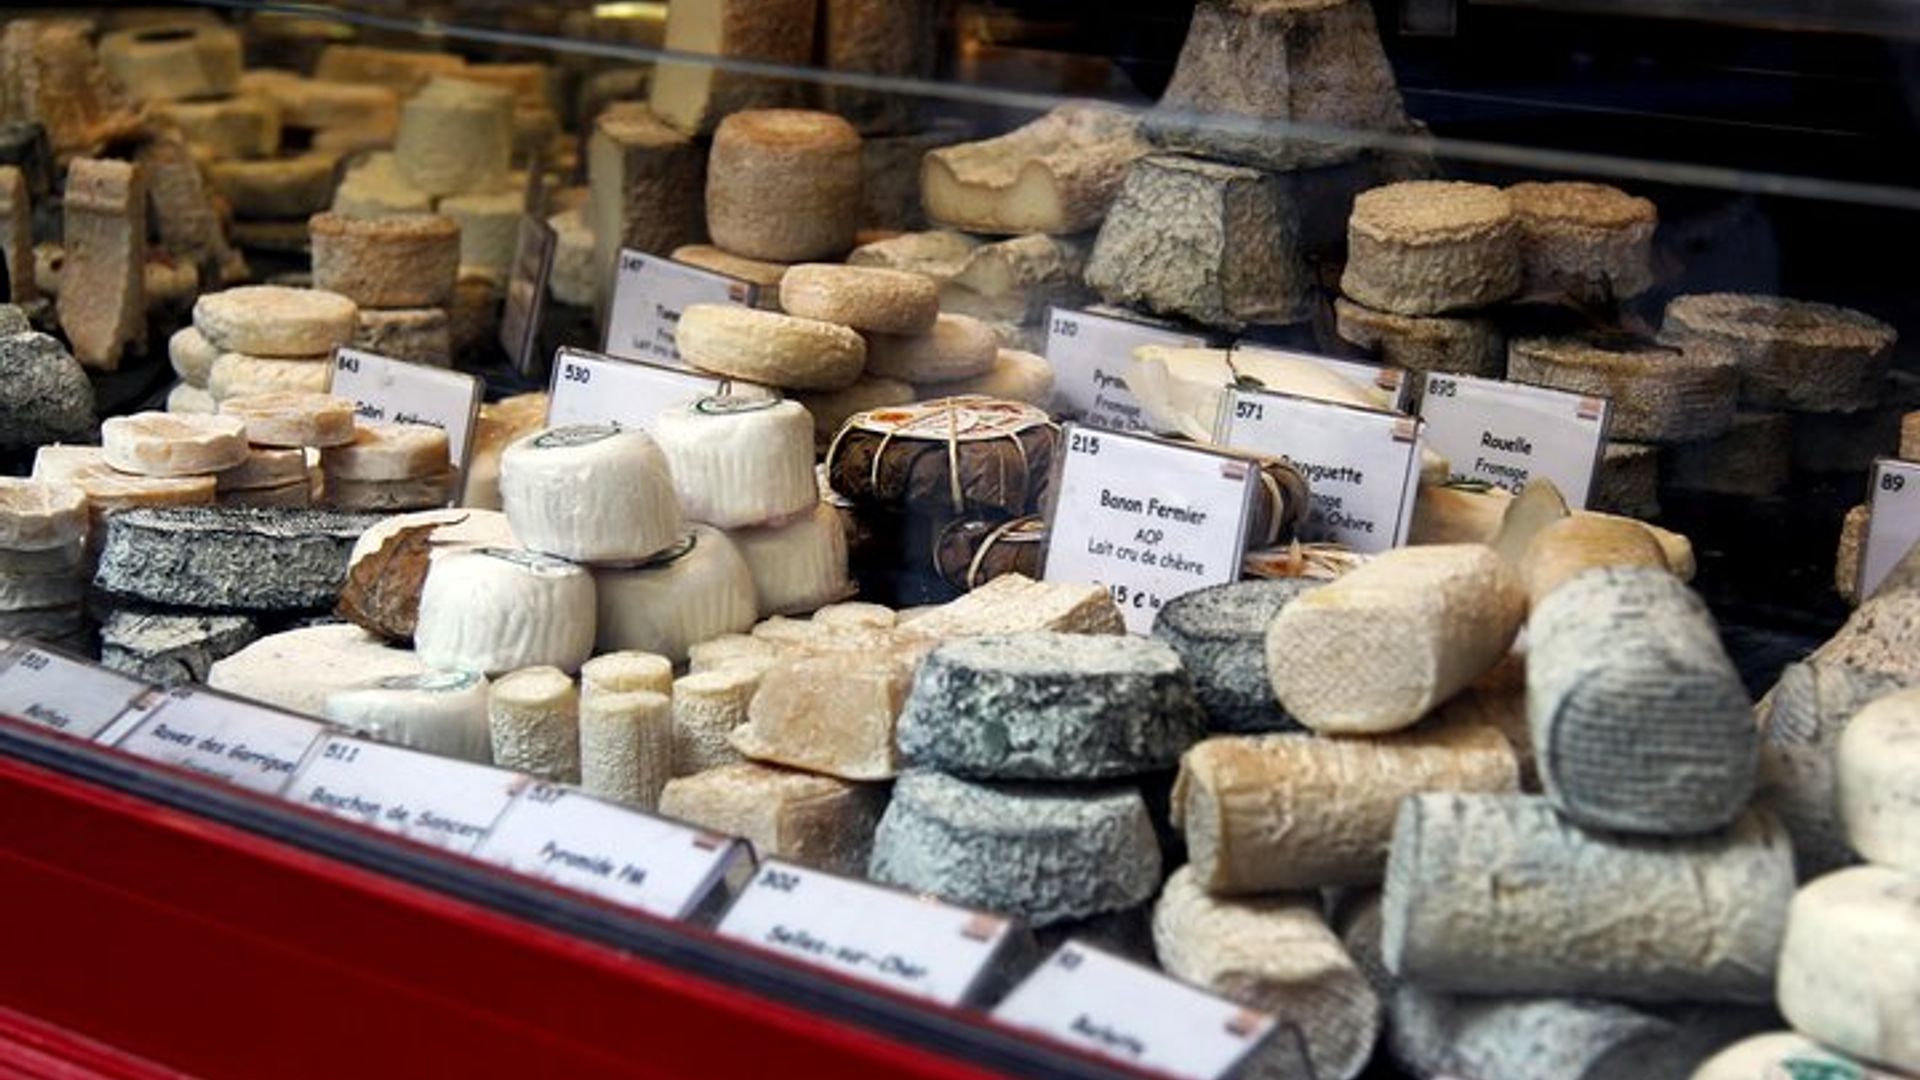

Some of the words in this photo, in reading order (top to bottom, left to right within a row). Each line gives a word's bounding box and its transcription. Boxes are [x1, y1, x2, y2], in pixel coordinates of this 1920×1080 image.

[1053, 319, 1079, 337] 120
[565, 363, 591, 384] 530
[1236, 401, 1264, 421] 571
[1071, 433, 1100, 455] 215
[1480, 430, 1533, 456] Rouelle
[1474, 457, 1529, 483] Fromage
[1881, 472, 1905, 493] 89
[1100, 488, 1142, 514] Banon
[1146, 497, 1207, 526] Fermier
[1133, 528, 1164, 546] AOP
[1087, 536, 1114, 557] Lait
[1115, 546, 1138, 561] cru
[1141, 549, 1157, 566] de
[1159, 552, 1205, 576] chèvre
[323, 742, 361, 764] 511
